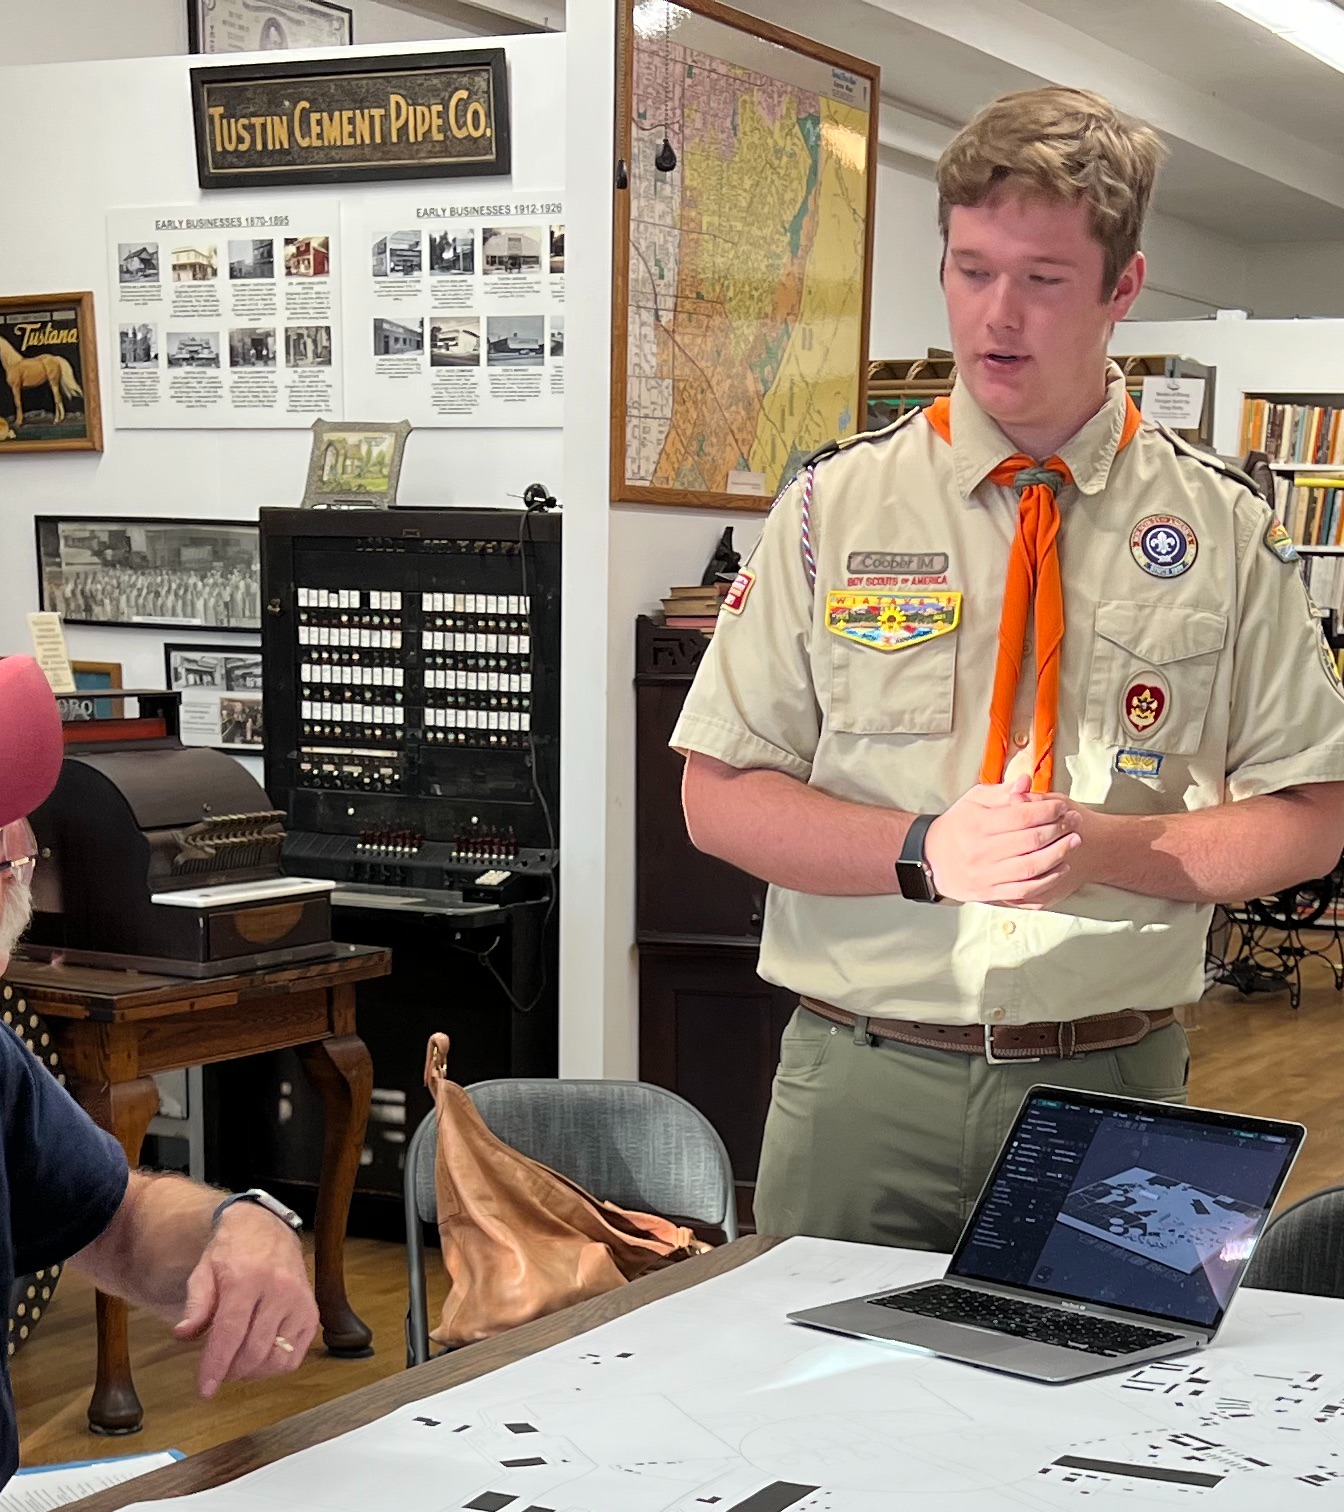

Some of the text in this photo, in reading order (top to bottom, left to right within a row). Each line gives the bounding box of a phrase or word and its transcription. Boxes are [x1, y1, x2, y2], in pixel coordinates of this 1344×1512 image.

[209, 89, 491, 152] TUSTIN CEMENT PIPE CO.
[417, 207, 447, 218] EARLY
[449, 205, 511, 216] BUSINESSES
[155, 215, 289, 230] EARLY BUSINESSES 1870-1895
[14, 322, 78, 351] Tustana
[863, 556, 913, 570] Cooper
[866, 577, 897, 586] SCOUTS
[911, 575, 947, 585] AMERICA
